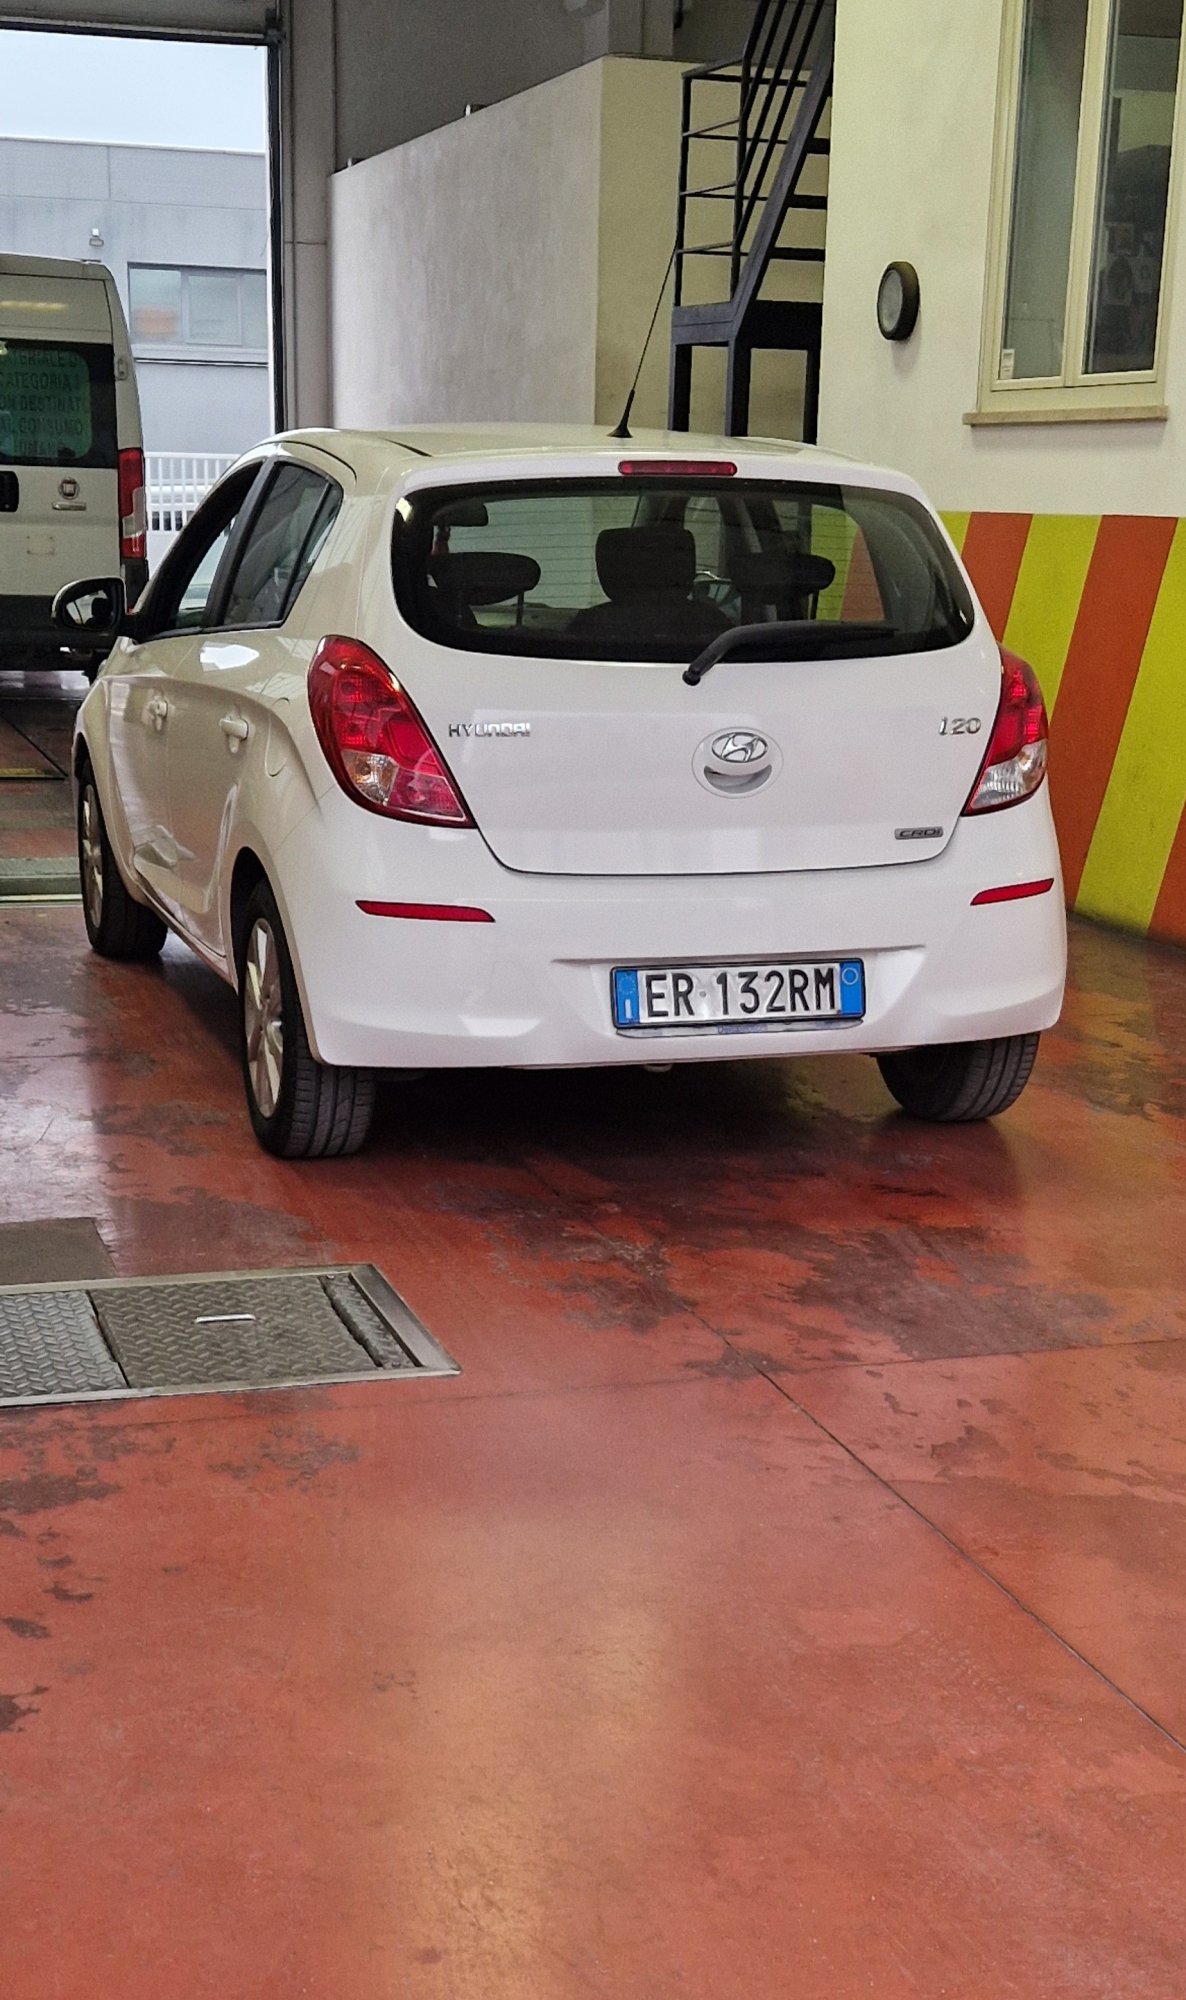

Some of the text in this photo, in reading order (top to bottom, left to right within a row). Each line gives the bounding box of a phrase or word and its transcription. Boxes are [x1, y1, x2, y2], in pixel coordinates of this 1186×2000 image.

[448, 722, 531, 737] HYUNDAI
[645, 967, 836, 1018] ER 132RM
